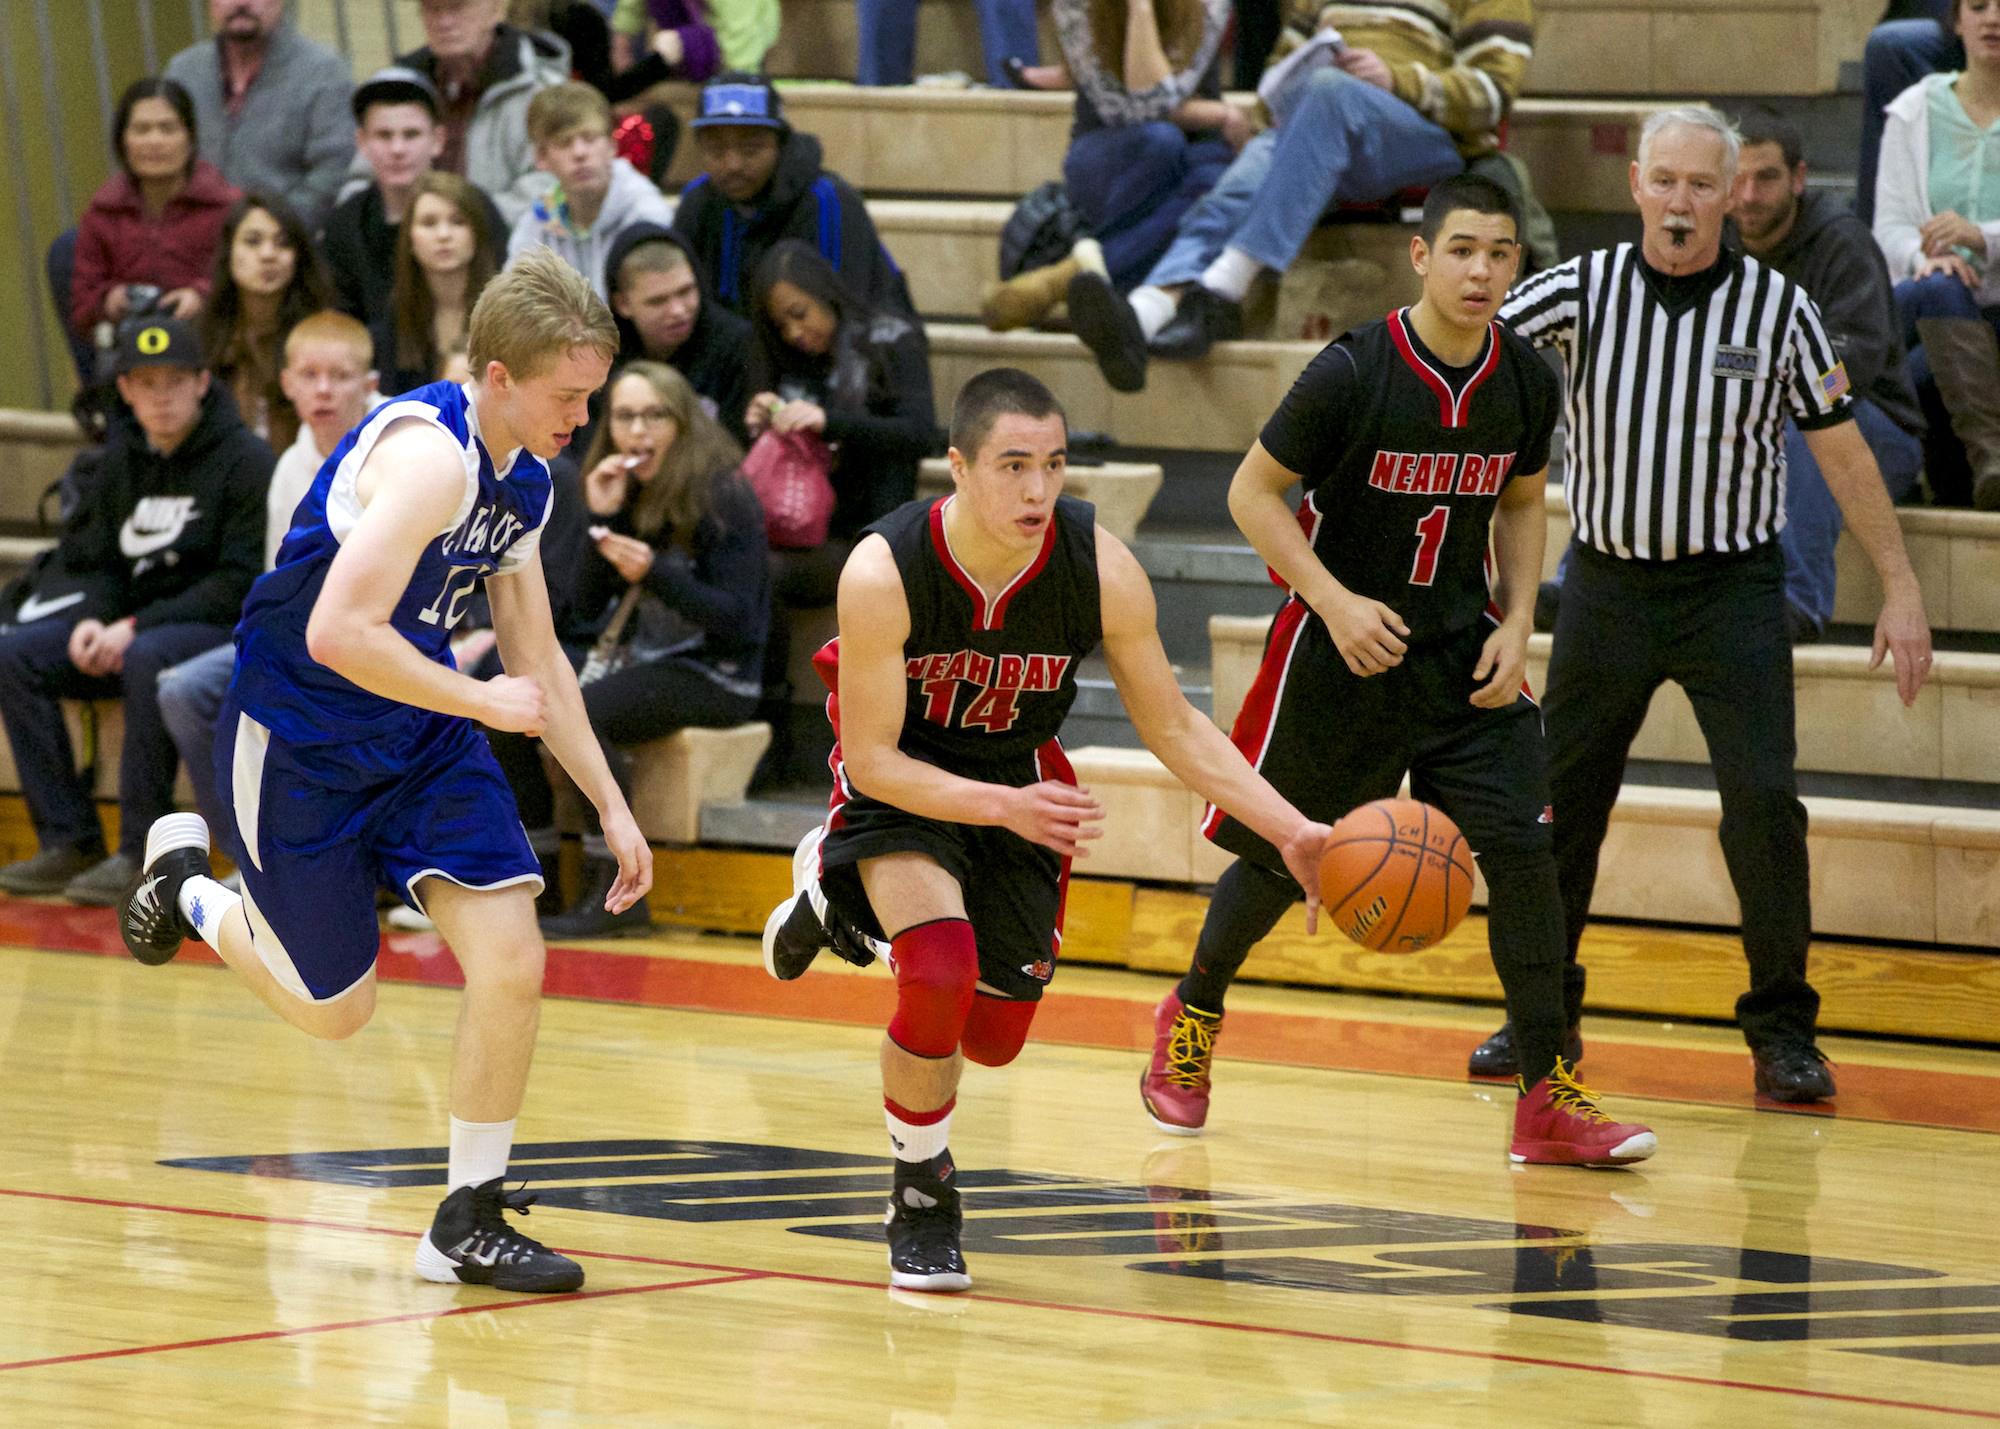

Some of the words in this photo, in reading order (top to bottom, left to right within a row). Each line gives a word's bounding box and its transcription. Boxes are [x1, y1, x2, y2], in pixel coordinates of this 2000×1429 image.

[1368, 450, 1459, 495] NEAH
[1409, 505, 1450, 586] 1
[905, 649, 995, 687] NEAH
[996, 654, 1071, 692] BAY
[921, 679, 1020, 733] 14
